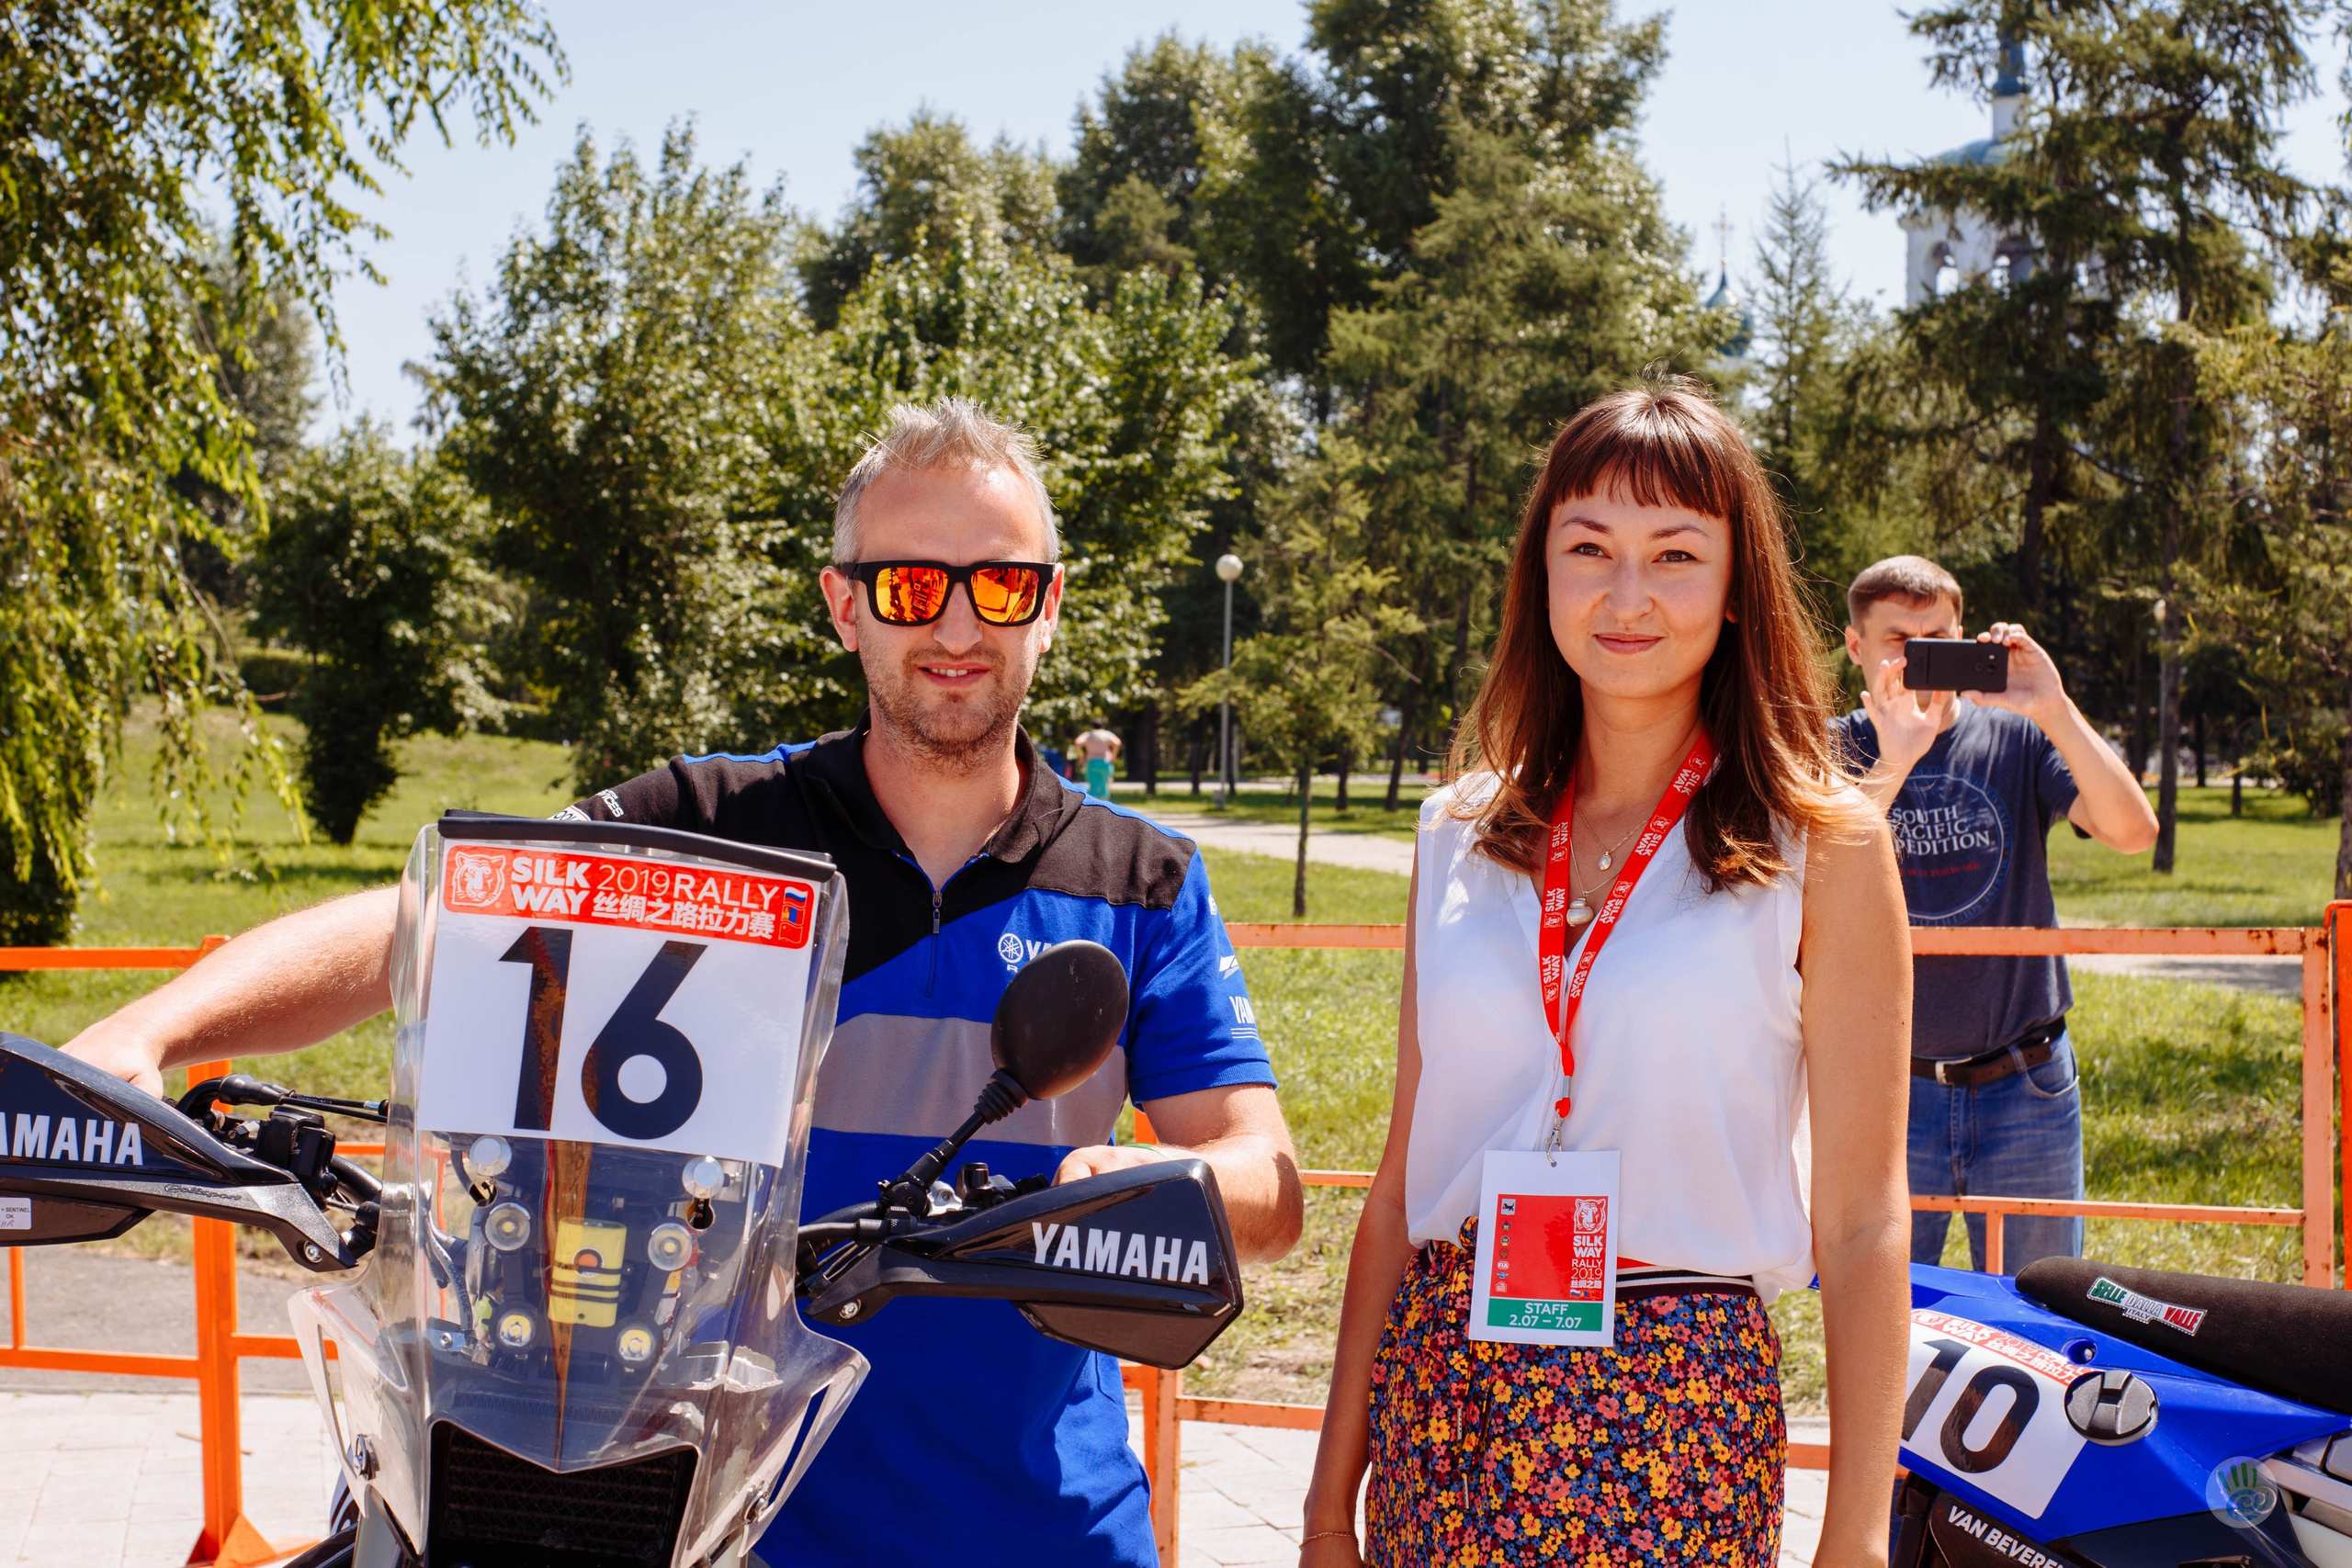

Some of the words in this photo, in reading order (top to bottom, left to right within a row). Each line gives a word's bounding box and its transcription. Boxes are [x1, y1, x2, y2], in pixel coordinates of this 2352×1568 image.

[1672, 768, 1692, 792] WAY
[1680, 772, 1700, 795] SILK
[1892, 805, 1960, 825] SOUTH
[1552, 823, 1561, 848] SILK
[1561, 821, 1569, 844] WAY
[1634, 831, 1654, 855] WAY
[1643, 833, 1662, 857] SILK
[1894, 830, 1991, 856] PEDITION
[511, 856, 592, 888] SILK
[597, 864, 671, 897] 2019
[674, 874, 779, 911] RALLY
[510, 885, 590, 915] WAY
[1545, 888, 1555, 913] SILK
[1555, 887, 1566, 910] WAY
[1599, 897, 1617, 923] WAY
[1607, 897, 1623, 924] SILK
[591, 890, 776, 940] 丝绸之路拉力赛
[1543, 955, 1552, 983] SILK
[1551, 954, 1561, 980] WAY
[1569, 970, 1581, 998] WAY
[1575, 970, 1588, 998] SILK
[497, 926, 708, 1140] 16
[1031, 1221, 1209, 1285] YAMAHA
[1573, 1235, 1603, 1247] SILK
[1573, 1247, 1603, 1258] WAY
[1571, 1258, 1603, 1268] RALLY
[1571, 1268, 1603, 1280] 2019
[1524, 1303, 1568, 1315] STAFF
[2091, 1279, 2127, 1303] SELLE
[2125, 1293, 2163, 1316] DALLA
[2164, 1306, 2201, 1331] VALLE
[2127, 1308, 2150, 1320] ITALY
[1509, 1314, 1539, 1327] 2.07
[1555, 1316, 1582, 1329] 7.07
[1946, 1319, 1992, 1338] SILK
[1942, 1325, 1990, 1345] WAY
[1903, 1338, 2040, 1473] 10
[1948, 1505, 1988, 1540] VAN
